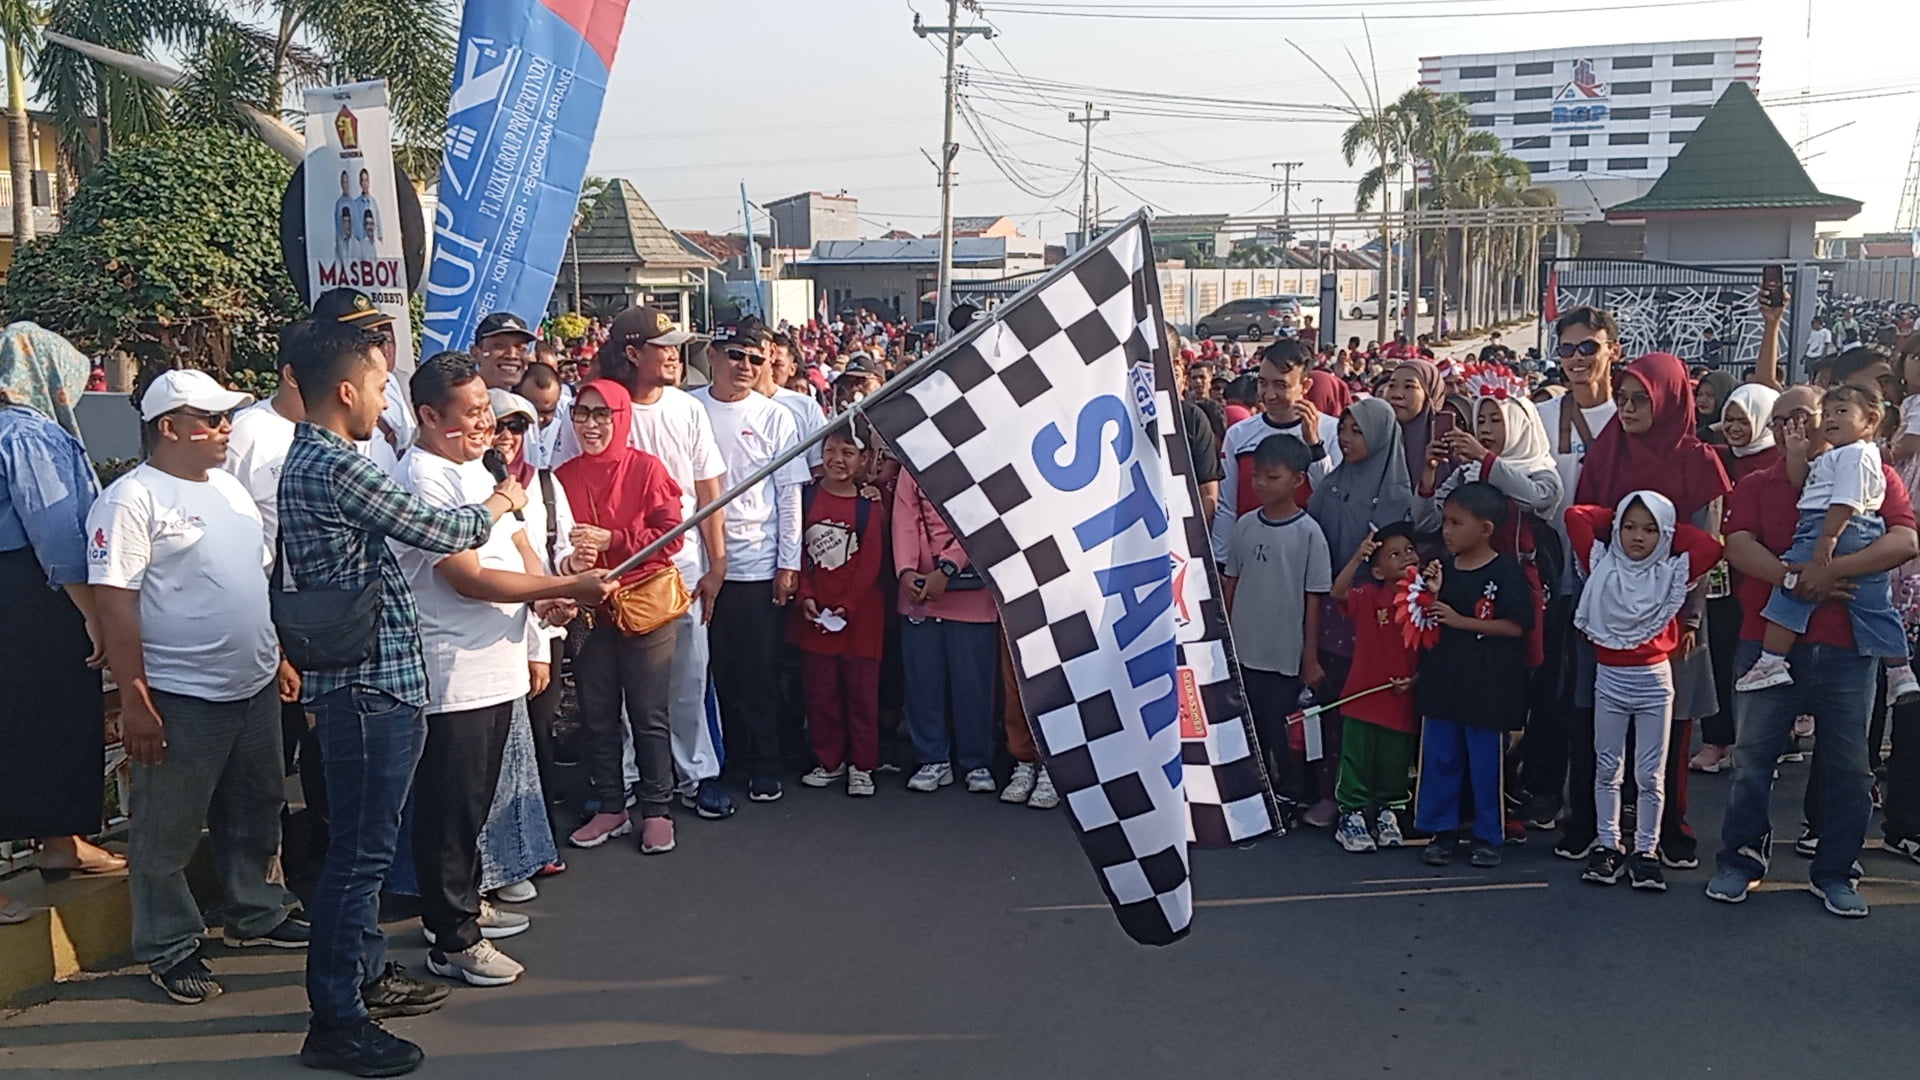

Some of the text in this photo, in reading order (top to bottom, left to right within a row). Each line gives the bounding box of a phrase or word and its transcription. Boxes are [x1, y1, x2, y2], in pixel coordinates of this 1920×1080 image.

[478, 55, 548, 220] PT. RIZKI GROUP PROPERTYNDO
[491, 204, 528, 284] KONTRAKTOR
[523, 121, 554, 196] PENGADAAN
[546, 68, 574, 121] BARANG
[318, 260, 398, 287] MASBOY
[1131, 367, 1157, 417] RGP
[1031, 393, 1183, 790] STAR
